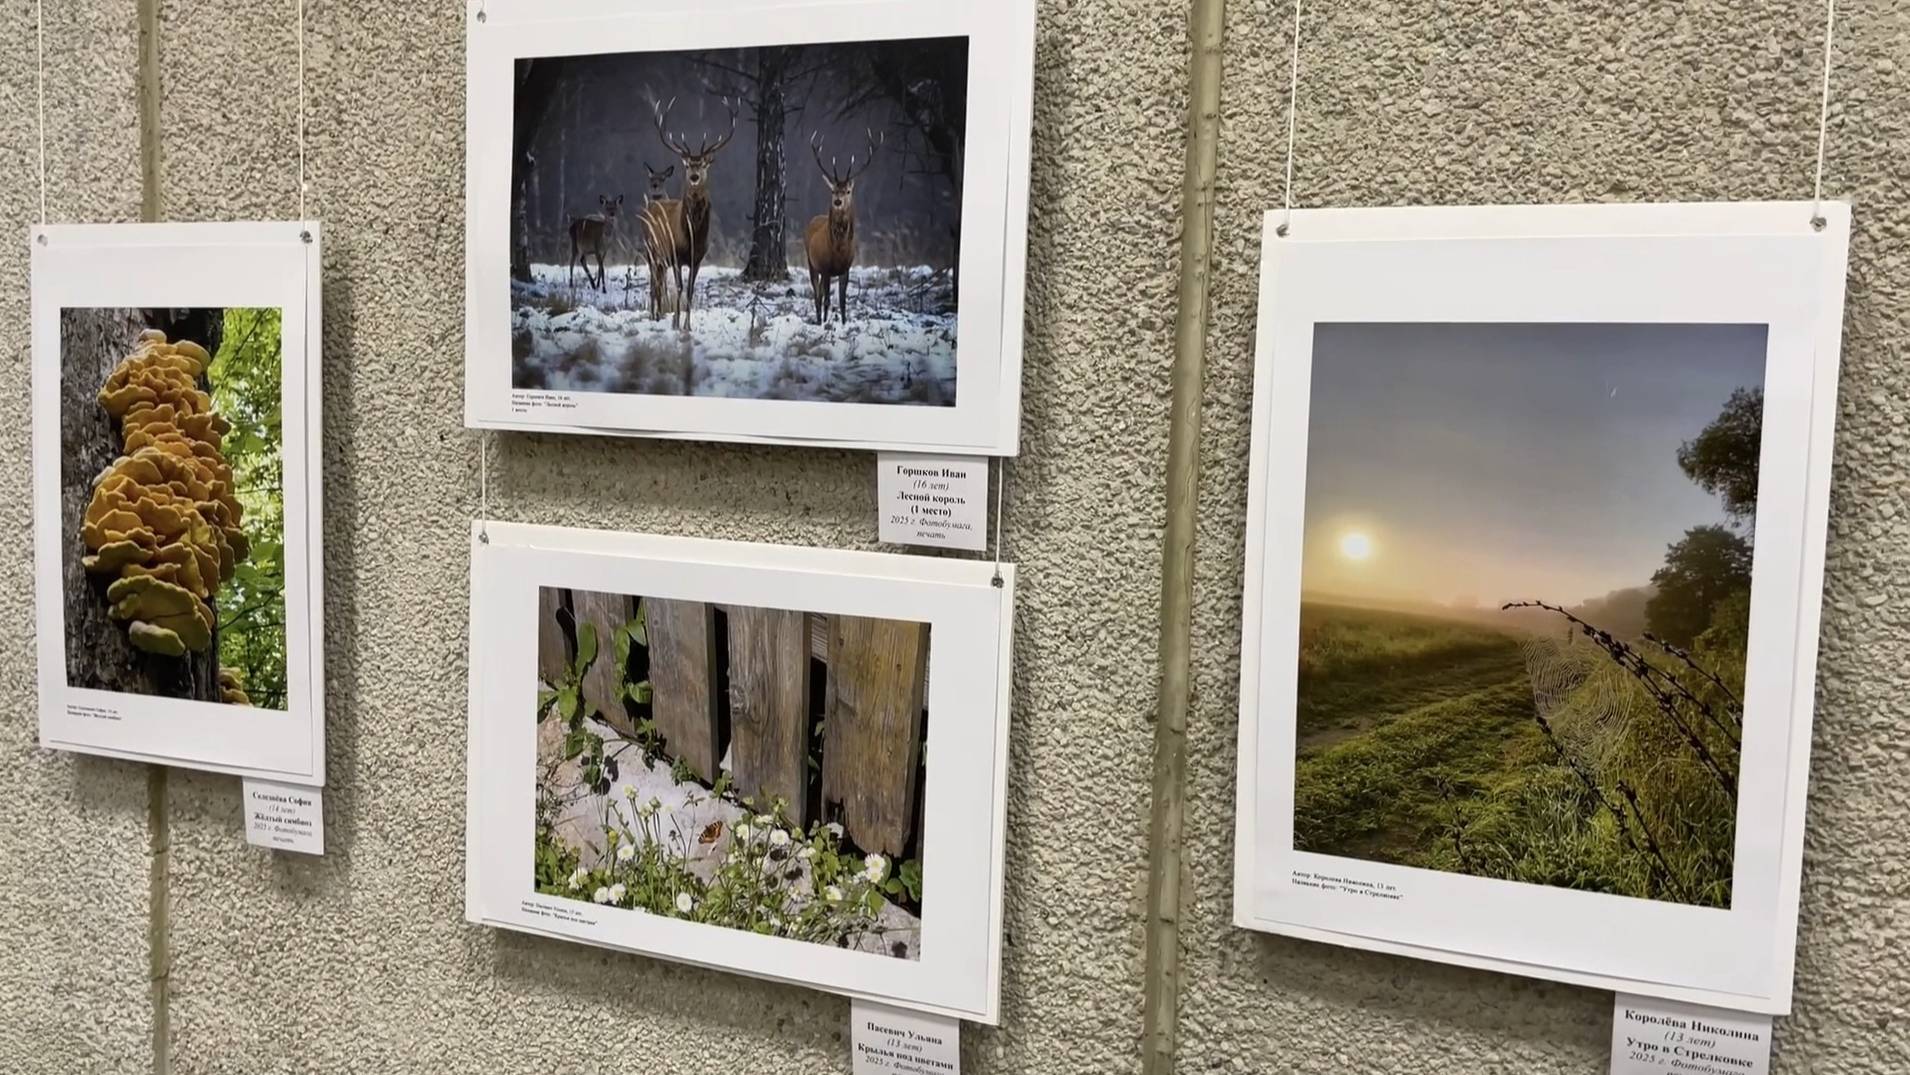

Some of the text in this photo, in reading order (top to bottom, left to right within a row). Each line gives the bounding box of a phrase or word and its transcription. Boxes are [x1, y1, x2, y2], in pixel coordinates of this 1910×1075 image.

[897, 465, 966, 479] Горшков Иван
[913, 480, 949, 491] (16 лет)
[897, 491, 965, 505] Лесной король
[911, 505, 951, 518] (1 место)
[890, 515, 909, 524] 2025
[916, 531, 945, 539] печать
[289, 797, 312, 806] София
[1625, 1009, 1759, 1042] Королёва Николина
[867, 1022, 942, 1045] Пасевич Ульяна
[1664, 1031, 1716, 1048] (13 лет)
[887, 1039, 901, 1047] (13
[858, 1042, 953, 1070] Крылья под цветами
[1626, 1037, 1753, 1068] Утро в Стрелковке
[1629, 1051, 1655, 1063] 2025
[865, 1055, 883, 1065] 2025
